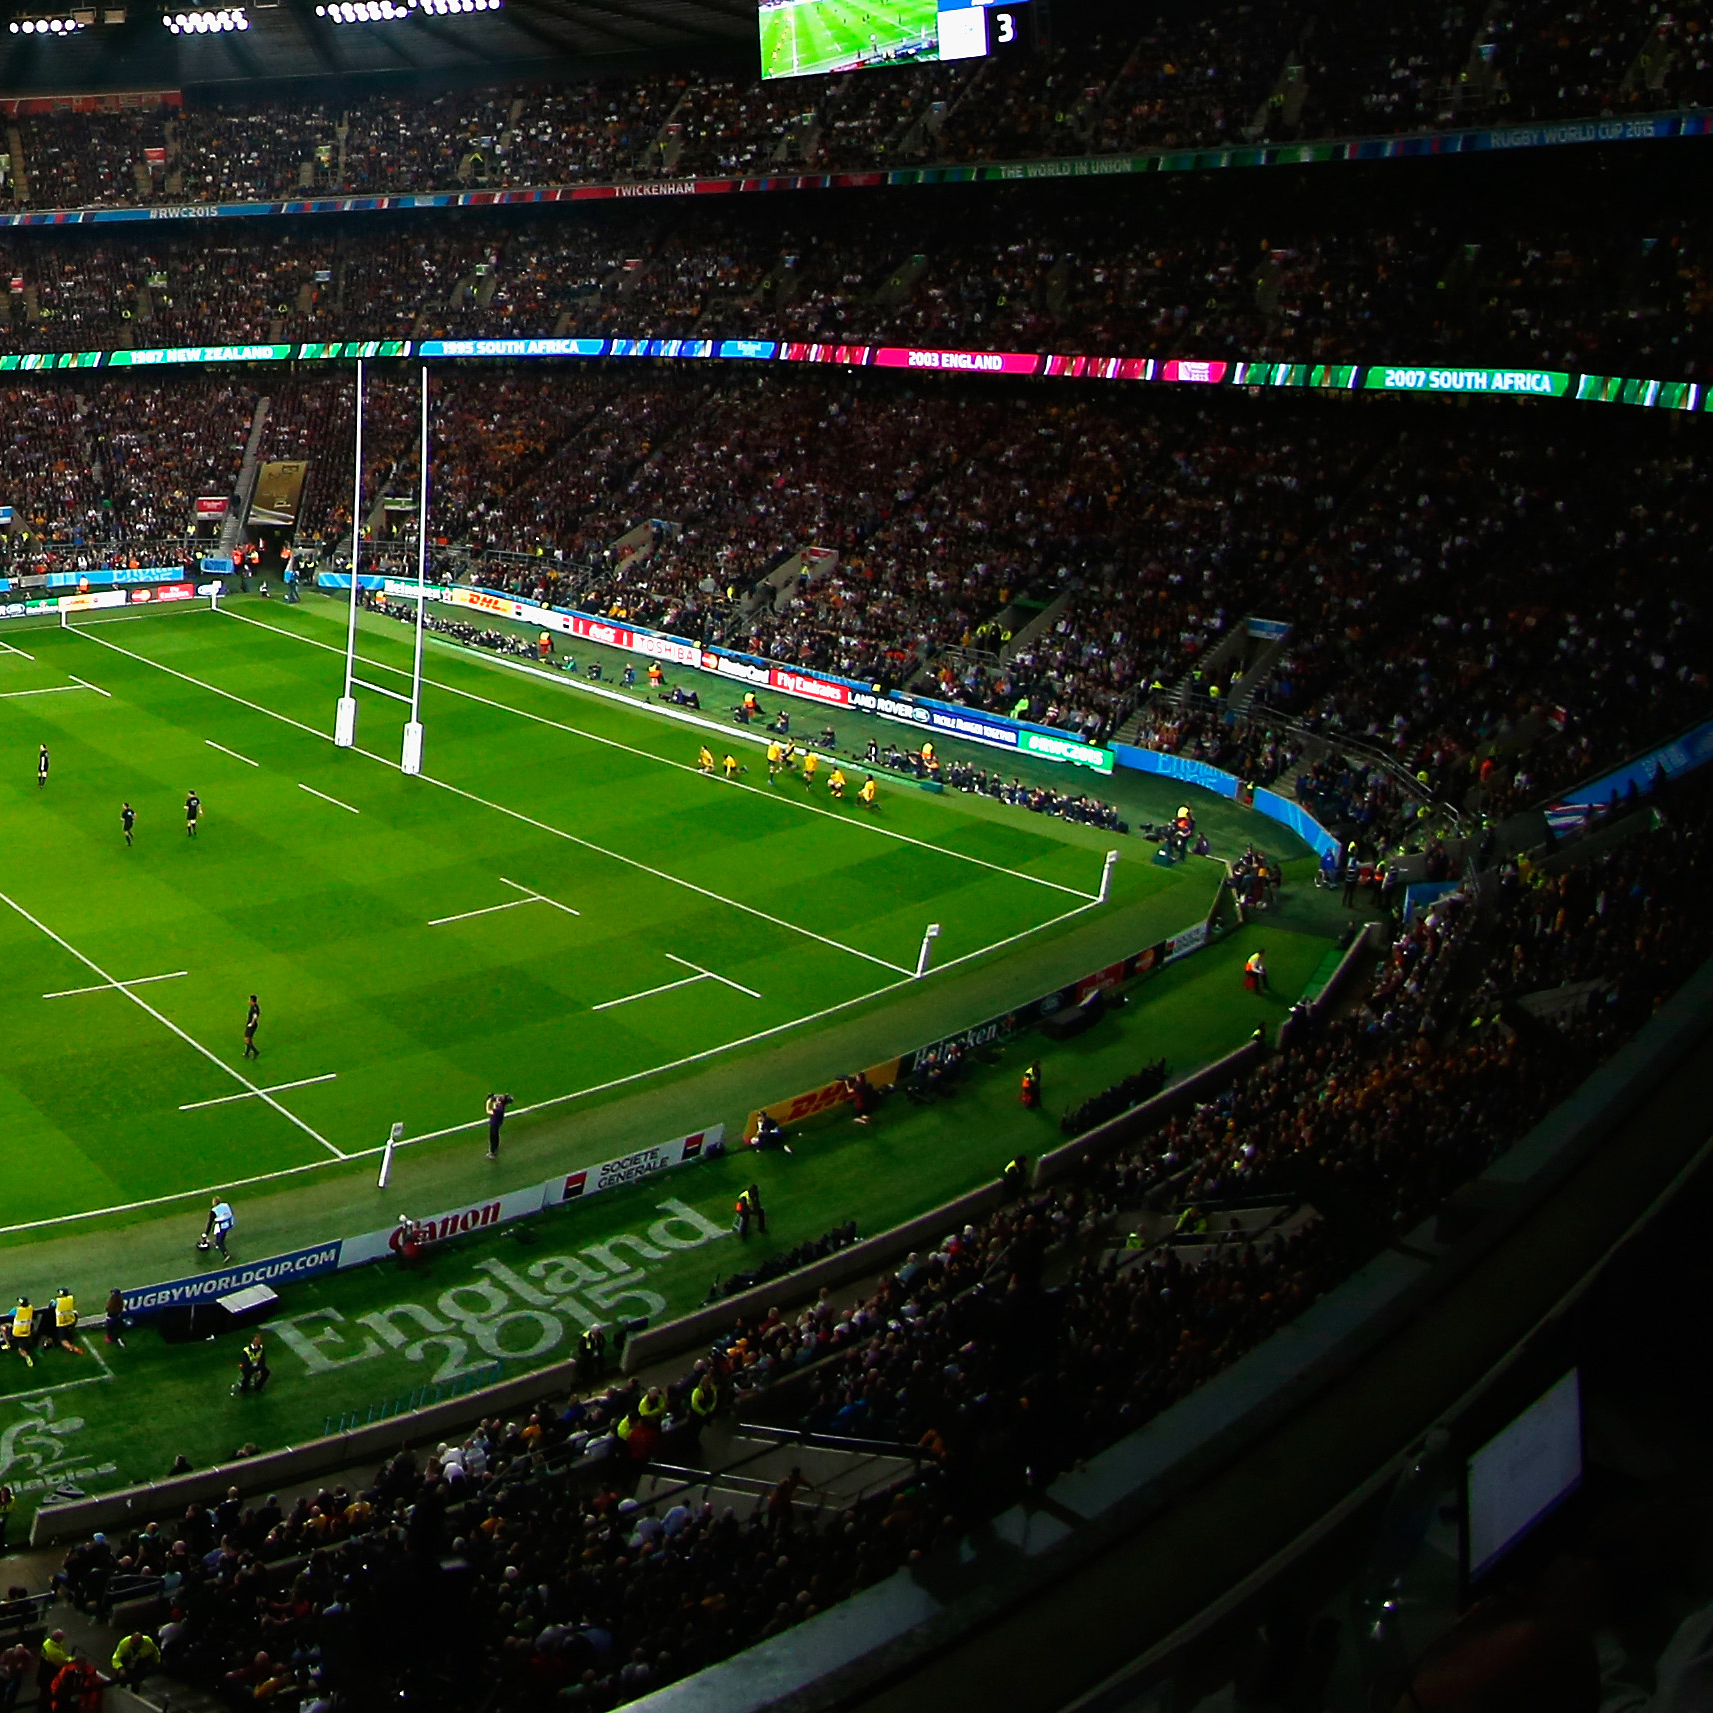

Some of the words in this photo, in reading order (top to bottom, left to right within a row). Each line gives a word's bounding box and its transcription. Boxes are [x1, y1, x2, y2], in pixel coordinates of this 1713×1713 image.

[996, 13, 1014, 43] 3
[615, 182, 695, 197] TWICKENHAM
[150, 207, 218, 219] #RWC2015
[130, 350, 165, 364] 1987
[166, 349, 202, 363] NEW
[204, 348, 274, 361] ZEALAND
[476, 340, 525, 354] SOUTH
[527, 339, 580, 354] AFRICA
[908, 351, 939, 367] 2003
[941, 353, 1003, 371] ENGLAND
[1385, 369, 1426, 387] 2007
[1428, 371, 1487, 390] SOUTH
[1491, 373, 1552, 392] AFRICA
[468, 593, 502, 611] DHL
[640, 638, 694, 661] TOSHIBA
[777, 671, 796, 691] Fly
[796, 676, 842, 700] Emirates
[847, 691, 875, 708] LAND
[877, 697, 913, 715] ROVER
[1028, 735, 1104, 766] #RWC2015
[598, 1156, 669, 1189] GENERALE
[600, 1147, 660, 1176] SOCIETE
[259, 1197, 742, 1376] England
[402, 1271, 670, 1384] 2015
